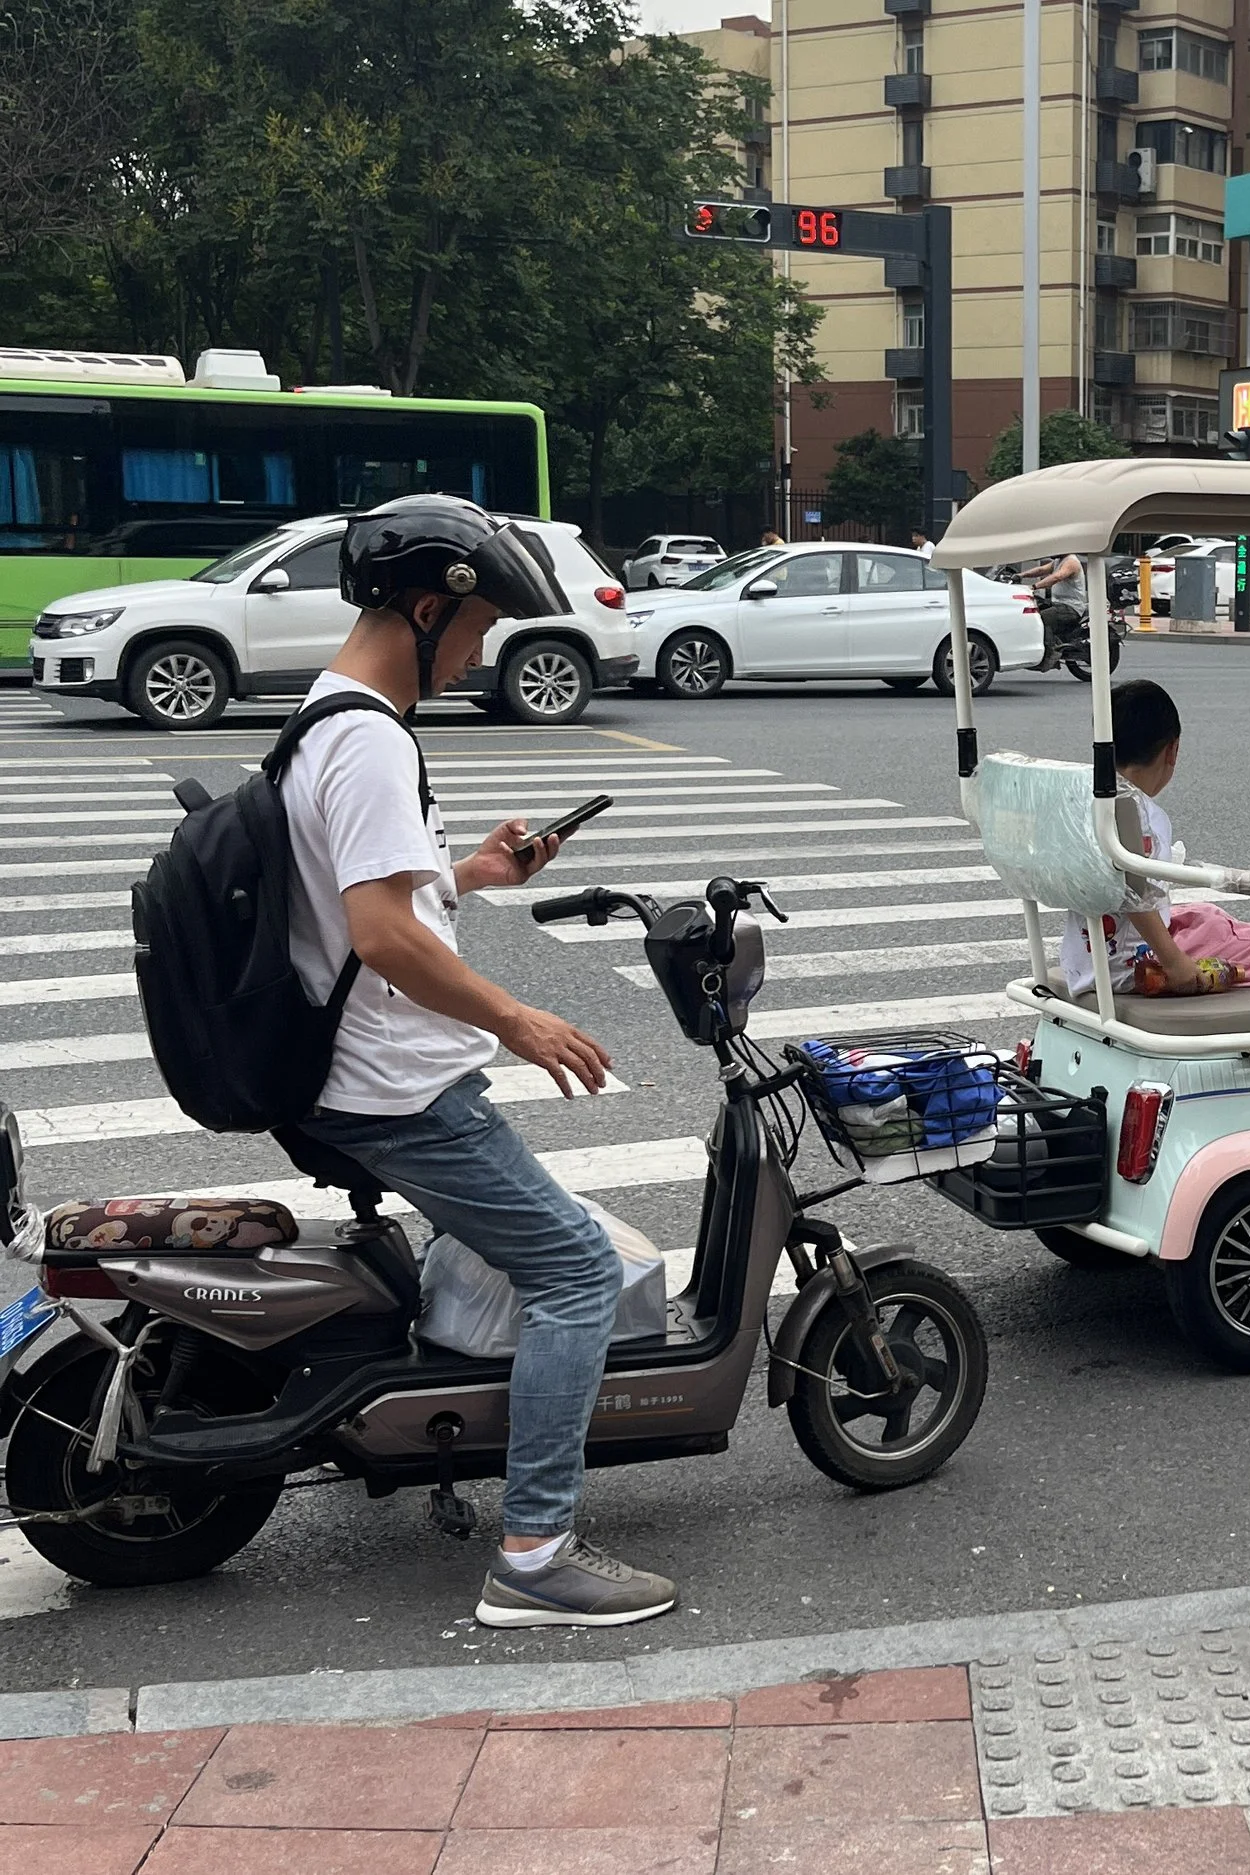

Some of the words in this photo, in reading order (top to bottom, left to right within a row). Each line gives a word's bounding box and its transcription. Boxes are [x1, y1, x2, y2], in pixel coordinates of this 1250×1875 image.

[798, 209, 839, 246] 96
[184, 1287, 262, 1302] CRANES
[597, 1394, 631, 1411] 千鹤
